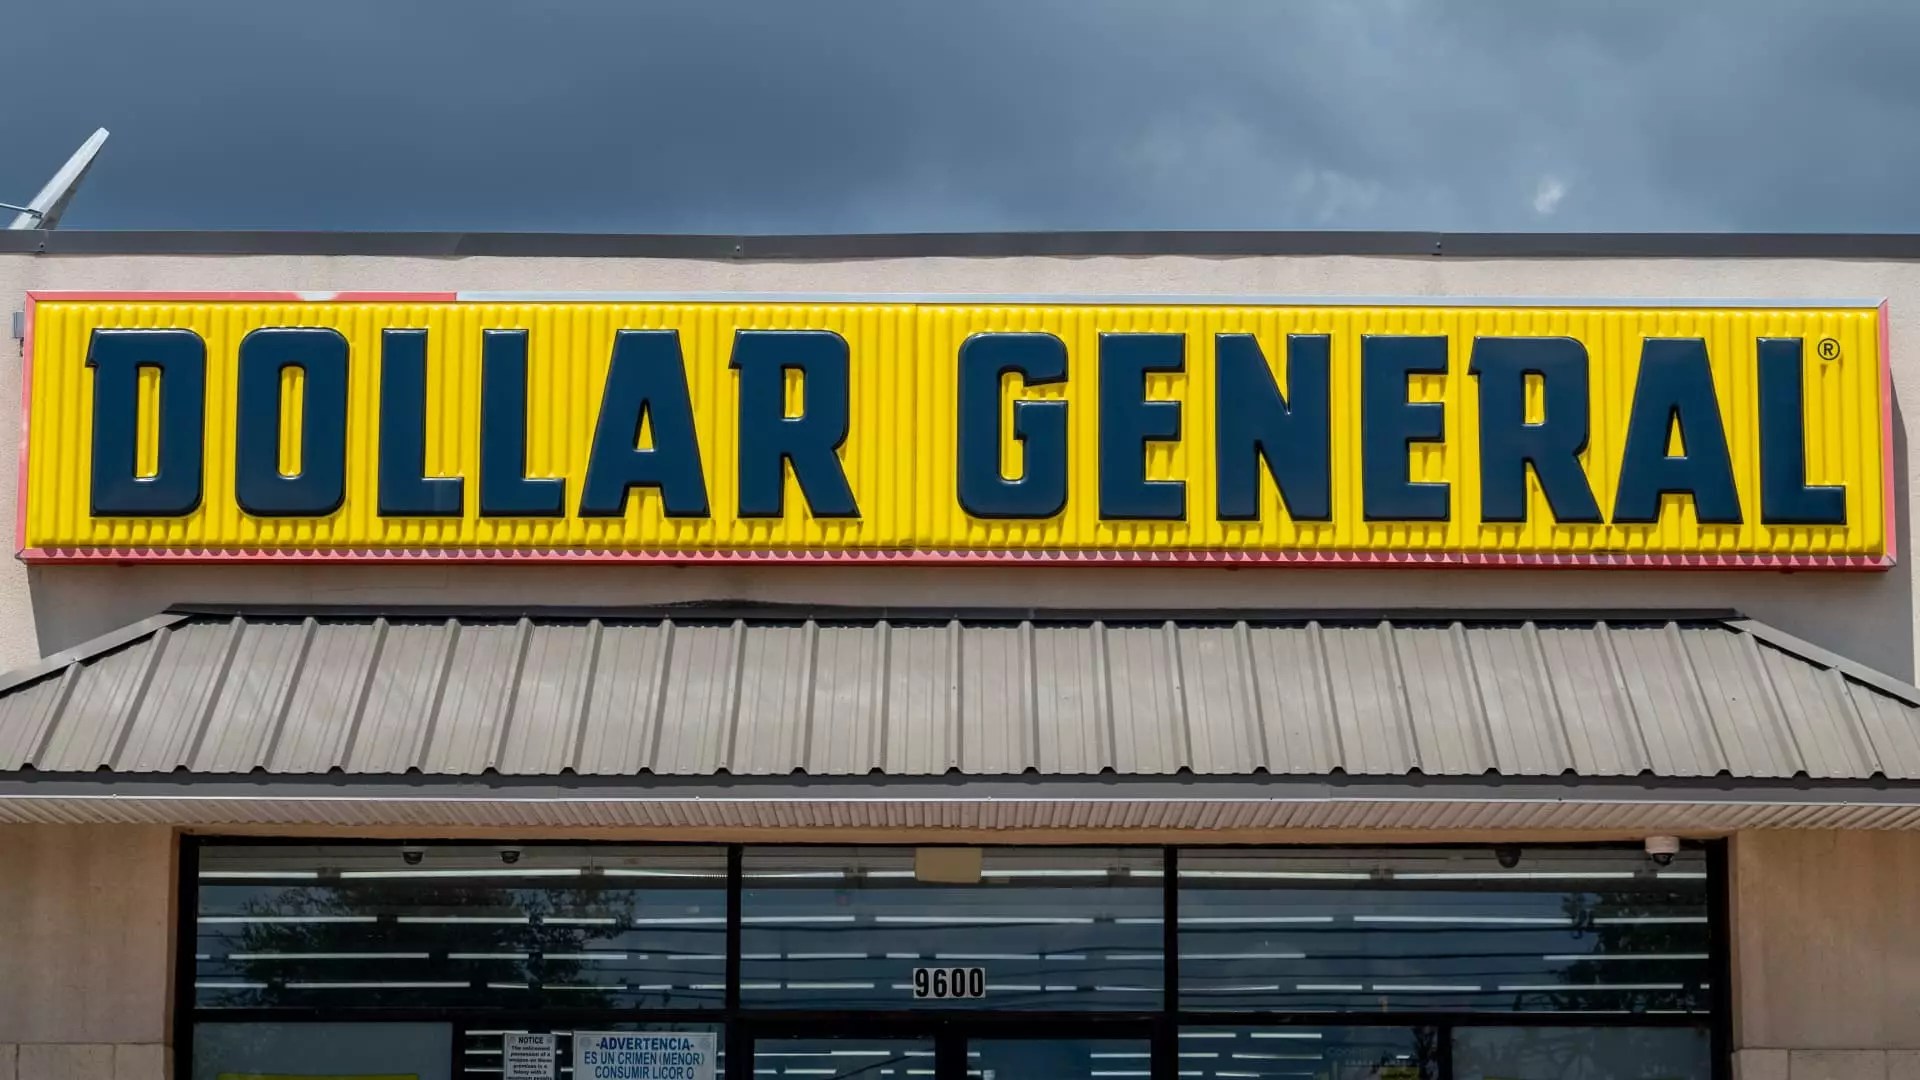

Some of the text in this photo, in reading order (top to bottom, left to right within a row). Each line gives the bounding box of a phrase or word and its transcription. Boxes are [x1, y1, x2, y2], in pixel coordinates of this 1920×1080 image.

[85, 327, 861, 519] DOLLAR
[956, 332, 1848, 526] GENERAL
[915, 968, 984, 998] 9600
[518, 1036, 544, 1044] NOTICE
[584, 1051, 705, 1066] ES UN CRIMEN (MENOR)
[595, 1066, 694, 1080] CONSUMIR LICOR O
